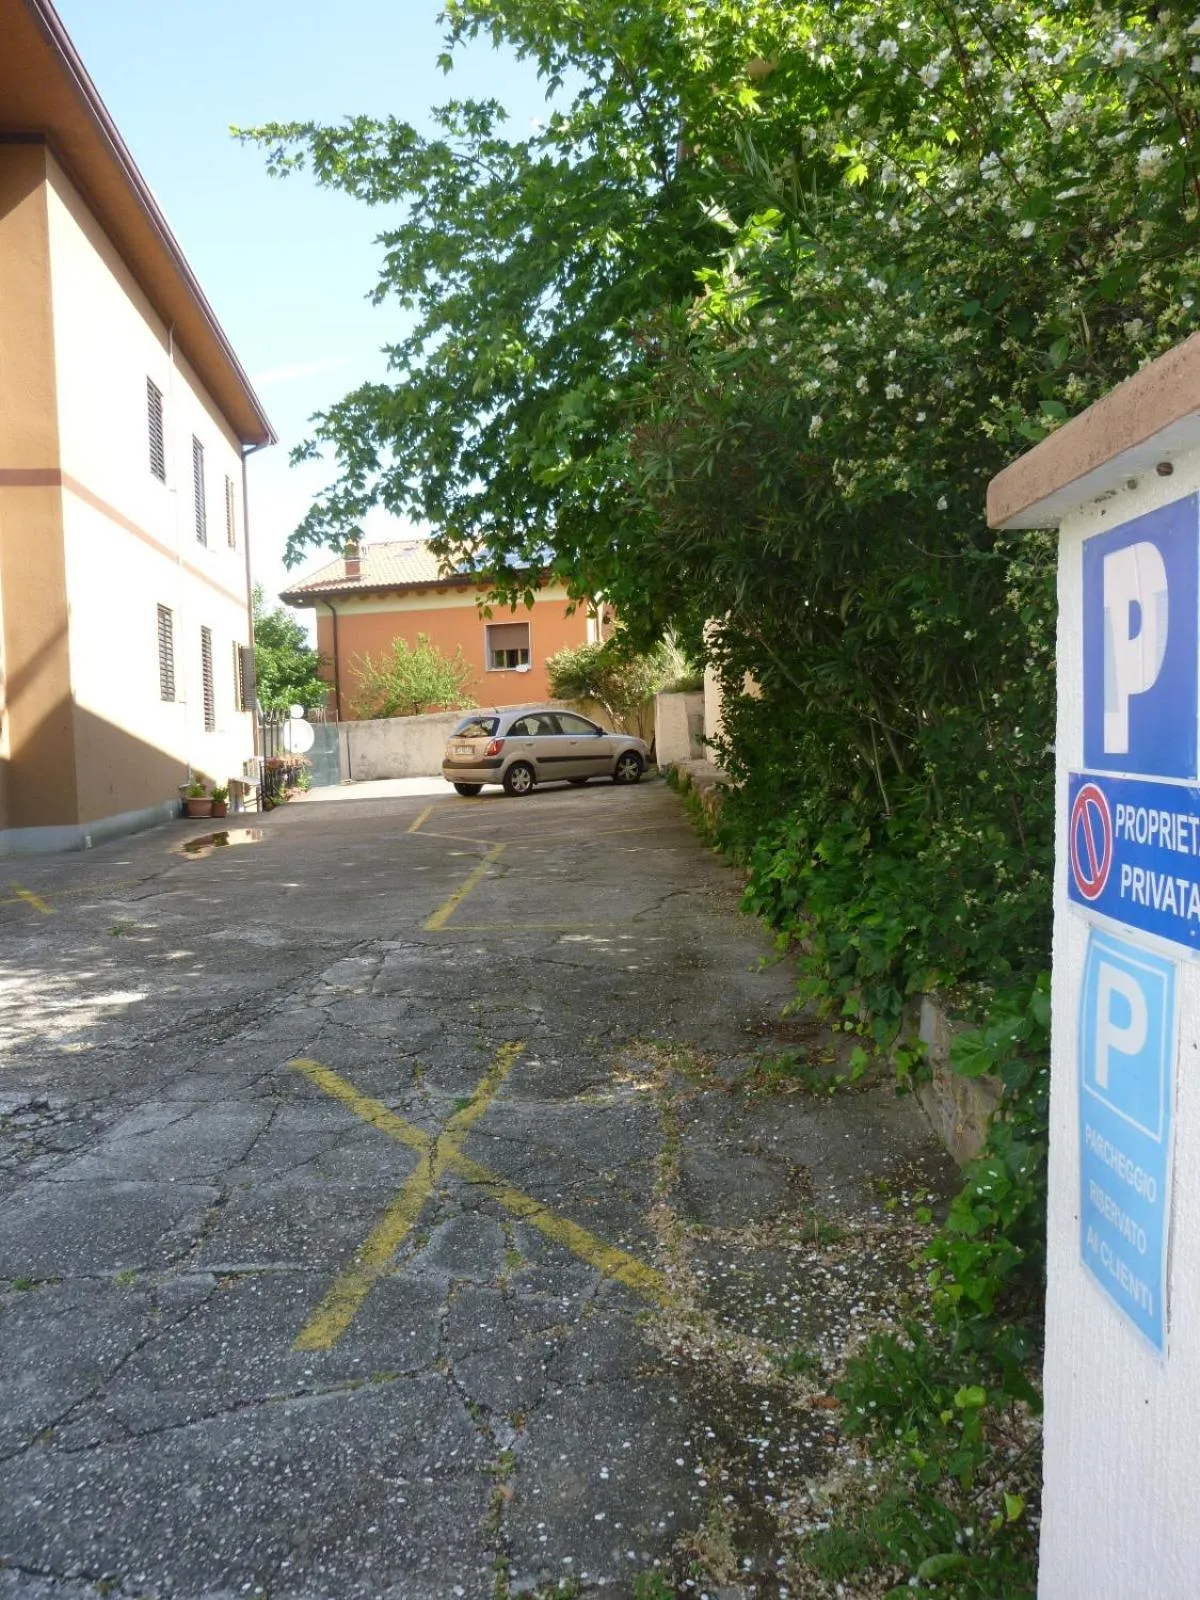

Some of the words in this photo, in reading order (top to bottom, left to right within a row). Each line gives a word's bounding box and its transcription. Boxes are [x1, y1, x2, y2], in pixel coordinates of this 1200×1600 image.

[1104, 541, 1169, 754] P
[1115, 803, 1200, 857] PROPRIET
[1120, 863, 1200, 924] PRIVATA
[1094, 962, 1148, 1090] P
[1085, 1123, 1157, 1203] PARCHEGGIO
[1089, 1179, 1147, 1255] RISERVATO
[1086, 1226, 1099, 1255] AI
[1100, 1242, 1154, 1317] CLIENTI
